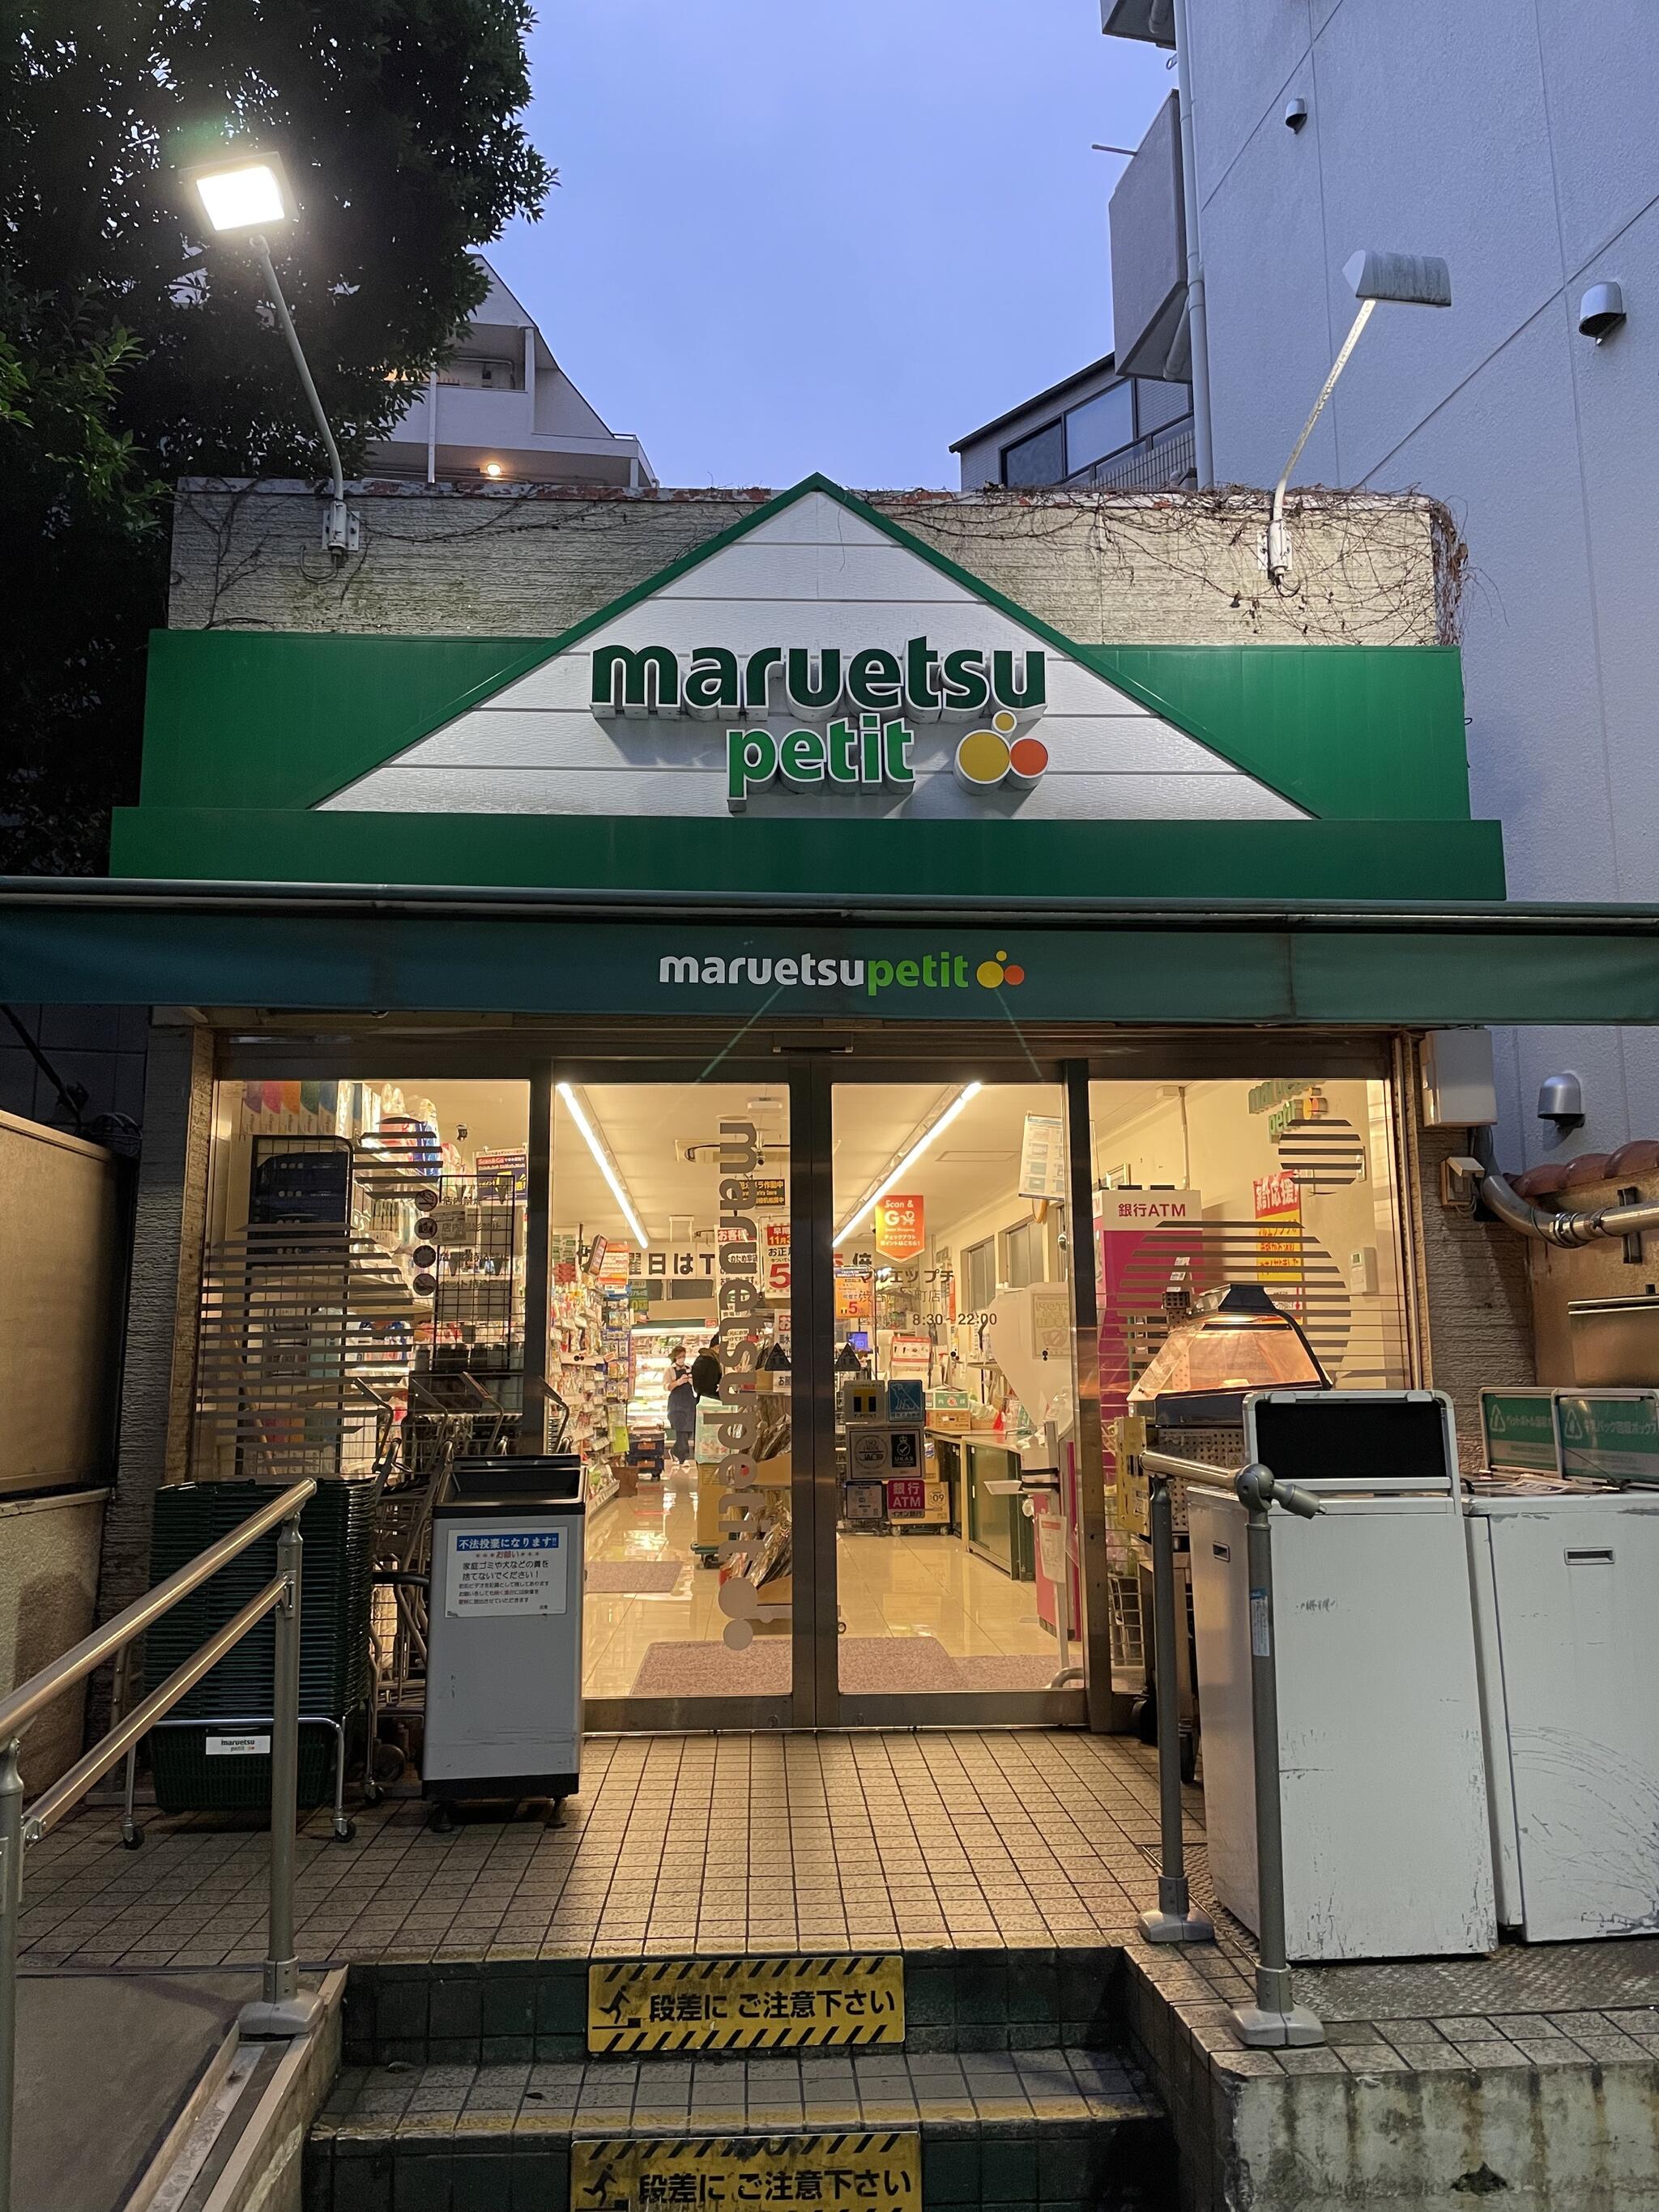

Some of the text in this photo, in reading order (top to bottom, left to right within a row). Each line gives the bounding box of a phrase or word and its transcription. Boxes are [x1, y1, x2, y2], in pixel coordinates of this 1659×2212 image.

[591, 635, 1047, 713] maruetsu
[726, 713, 916, 800] petit
[885, 1200, 904, 1208] Scan
[1118, 1204, 1186, 1217] 銀行ATM
[893, 1482, 920, 1495] 銀行
[893, 1497, 920, 1507] ATM
